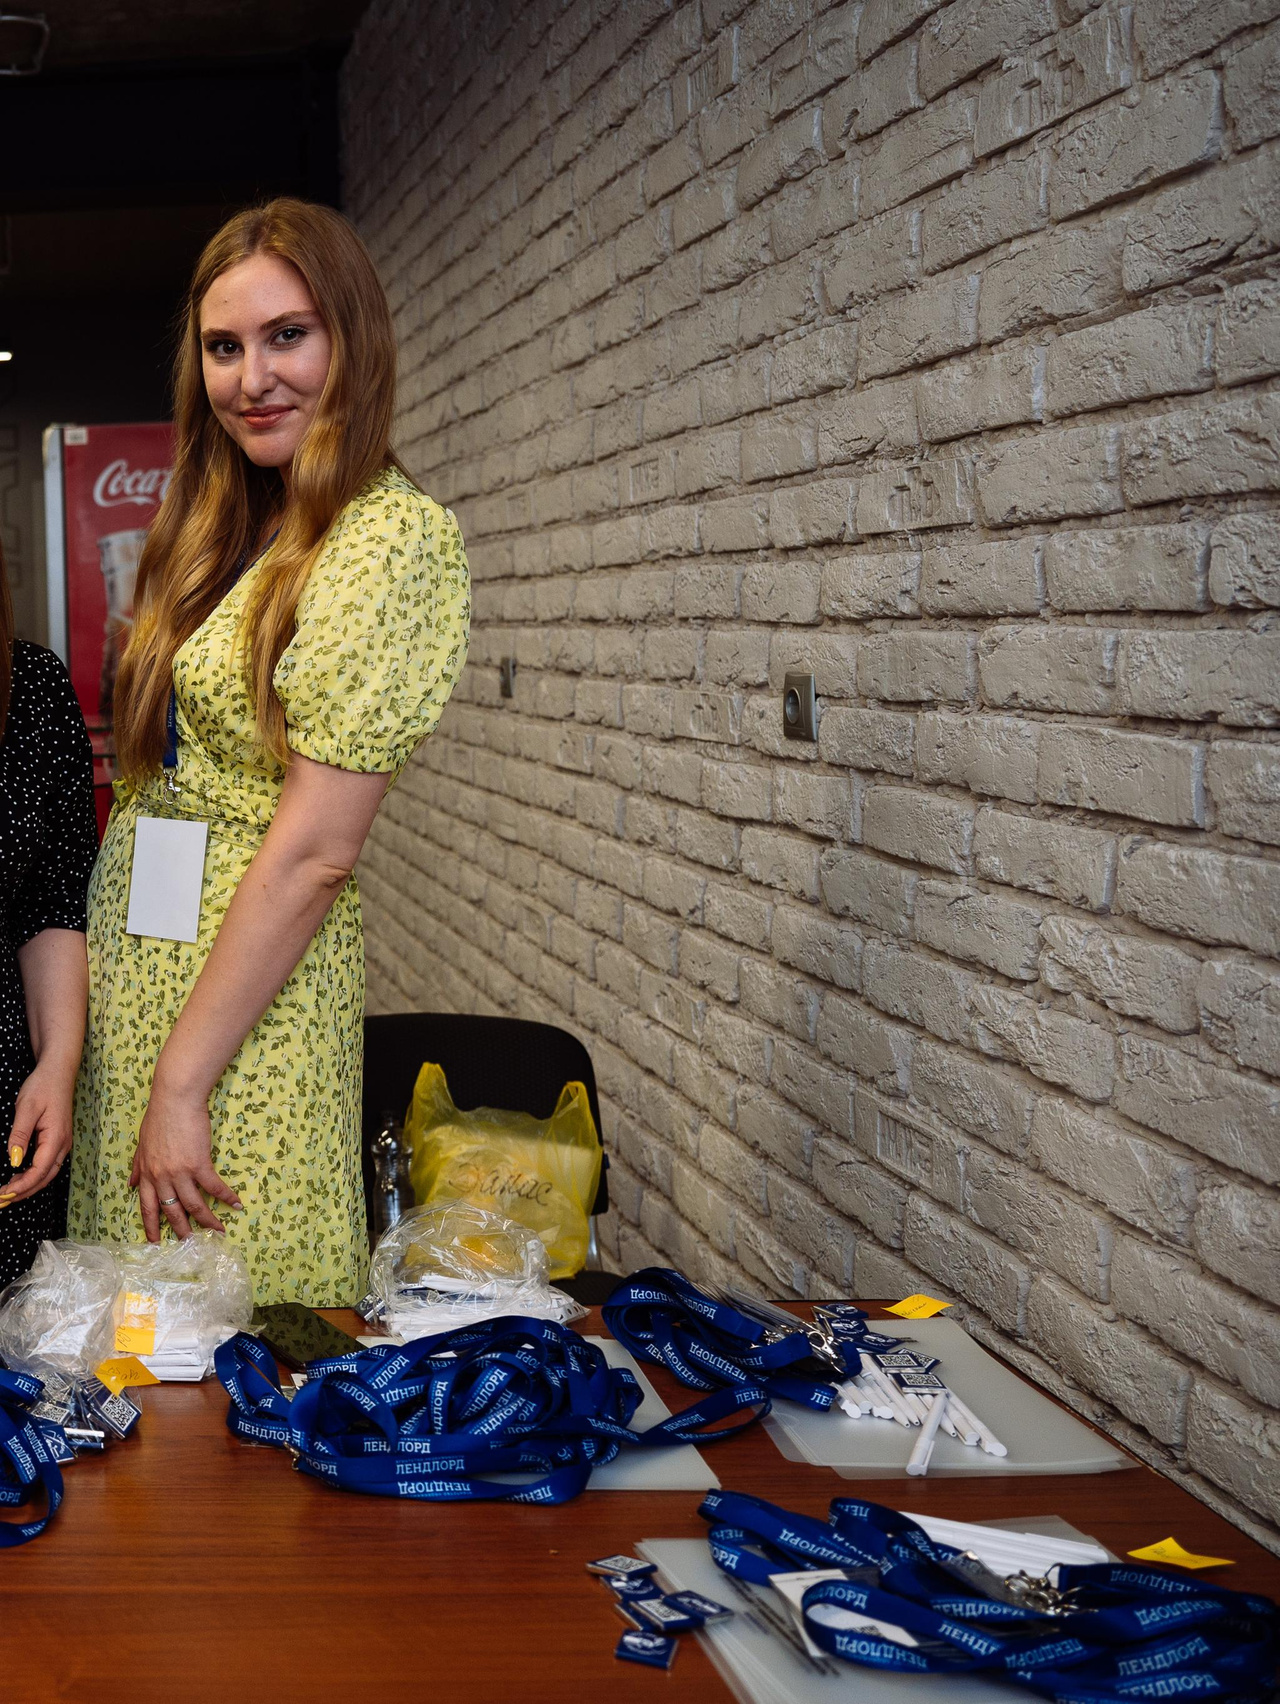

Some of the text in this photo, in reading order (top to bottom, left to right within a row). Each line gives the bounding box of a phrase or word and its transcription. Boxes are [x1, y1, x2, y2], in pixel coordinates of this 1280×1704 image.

[94, 459, 173, 507] Coca
[664, 1342, 714, 1390] ЛЕНДЛОРД
[690, 1341, 747, 1381] ЛЕНДЛОРД
[8, 1436, 37, 1480] ЛЕНДЛОРД
[25, 1421, 49, 1463] ЛЕНДЛОРД
[396, 1459, 465, 1475] ЛЕНДЛОРД
[397, 1481, 471, 1495] ЛЕНДЛОРД
[779, 1528, 863, 1567] ЛЕНДЛОРД
[835, 1634, 927, 1669] ЛЕНДЛОРД
[1006, 1639, 1082, 1669] ЛЕНДЛОРД
[1118, 1637, 1210, 1675] ЛЕНДЛОРД
